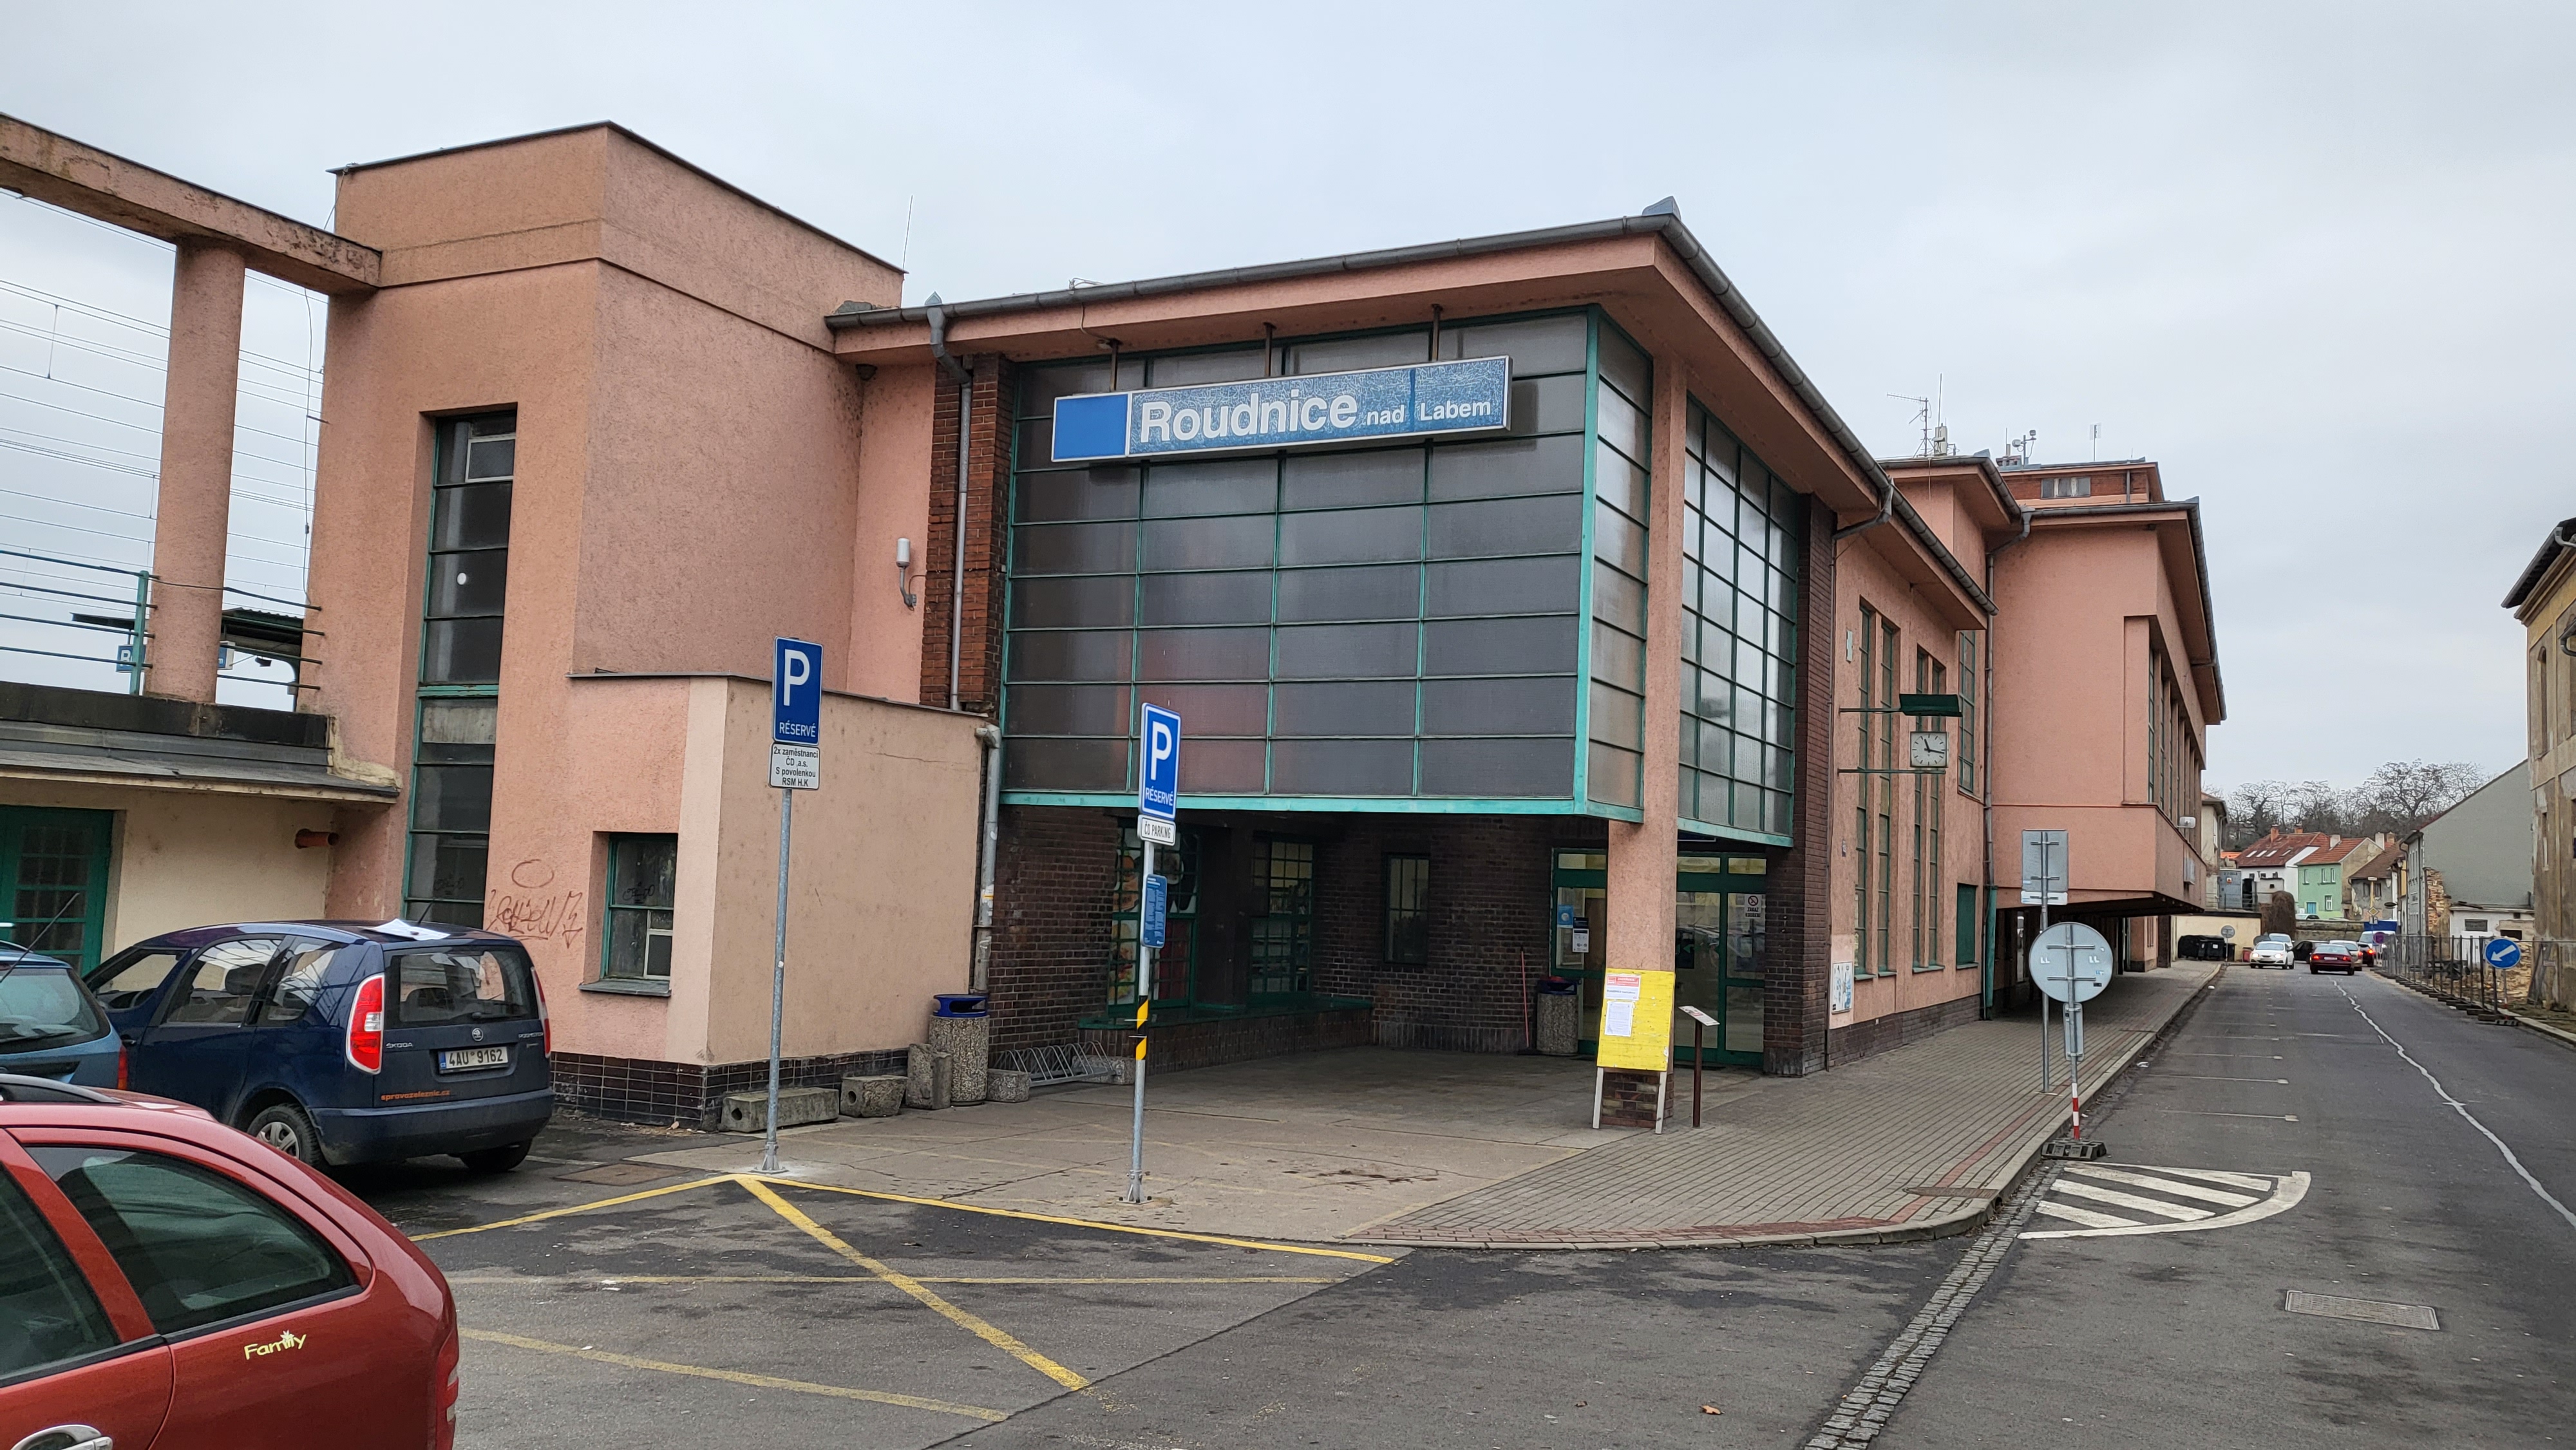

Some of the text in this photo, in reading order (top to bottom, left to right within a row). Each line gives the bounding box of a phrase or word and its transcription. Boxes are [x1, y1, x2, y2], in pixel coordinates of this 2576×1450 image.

[1140, 389, 1491, 444] Roudnice nad Labem
[783, 648, 810, 706] P
[779, 720, 817, 738] RÉSERVÉ
[773, 746, 818, 758] 2x zaměstnanci
[1151, 720, 1172, 780] P
[786, 756, 795, 766] ČD
[781, 768, 816, 778] povolenkou
[782, 777, 796, 786] RSM
[1145, 786, 1173, 806] RÉSERVÉ
[1144, 821, 1171, 838] ČD PARKING
[449, 1049, 503, 1066] 4AU 9162
[244, 1332, 307, 1360] Family
